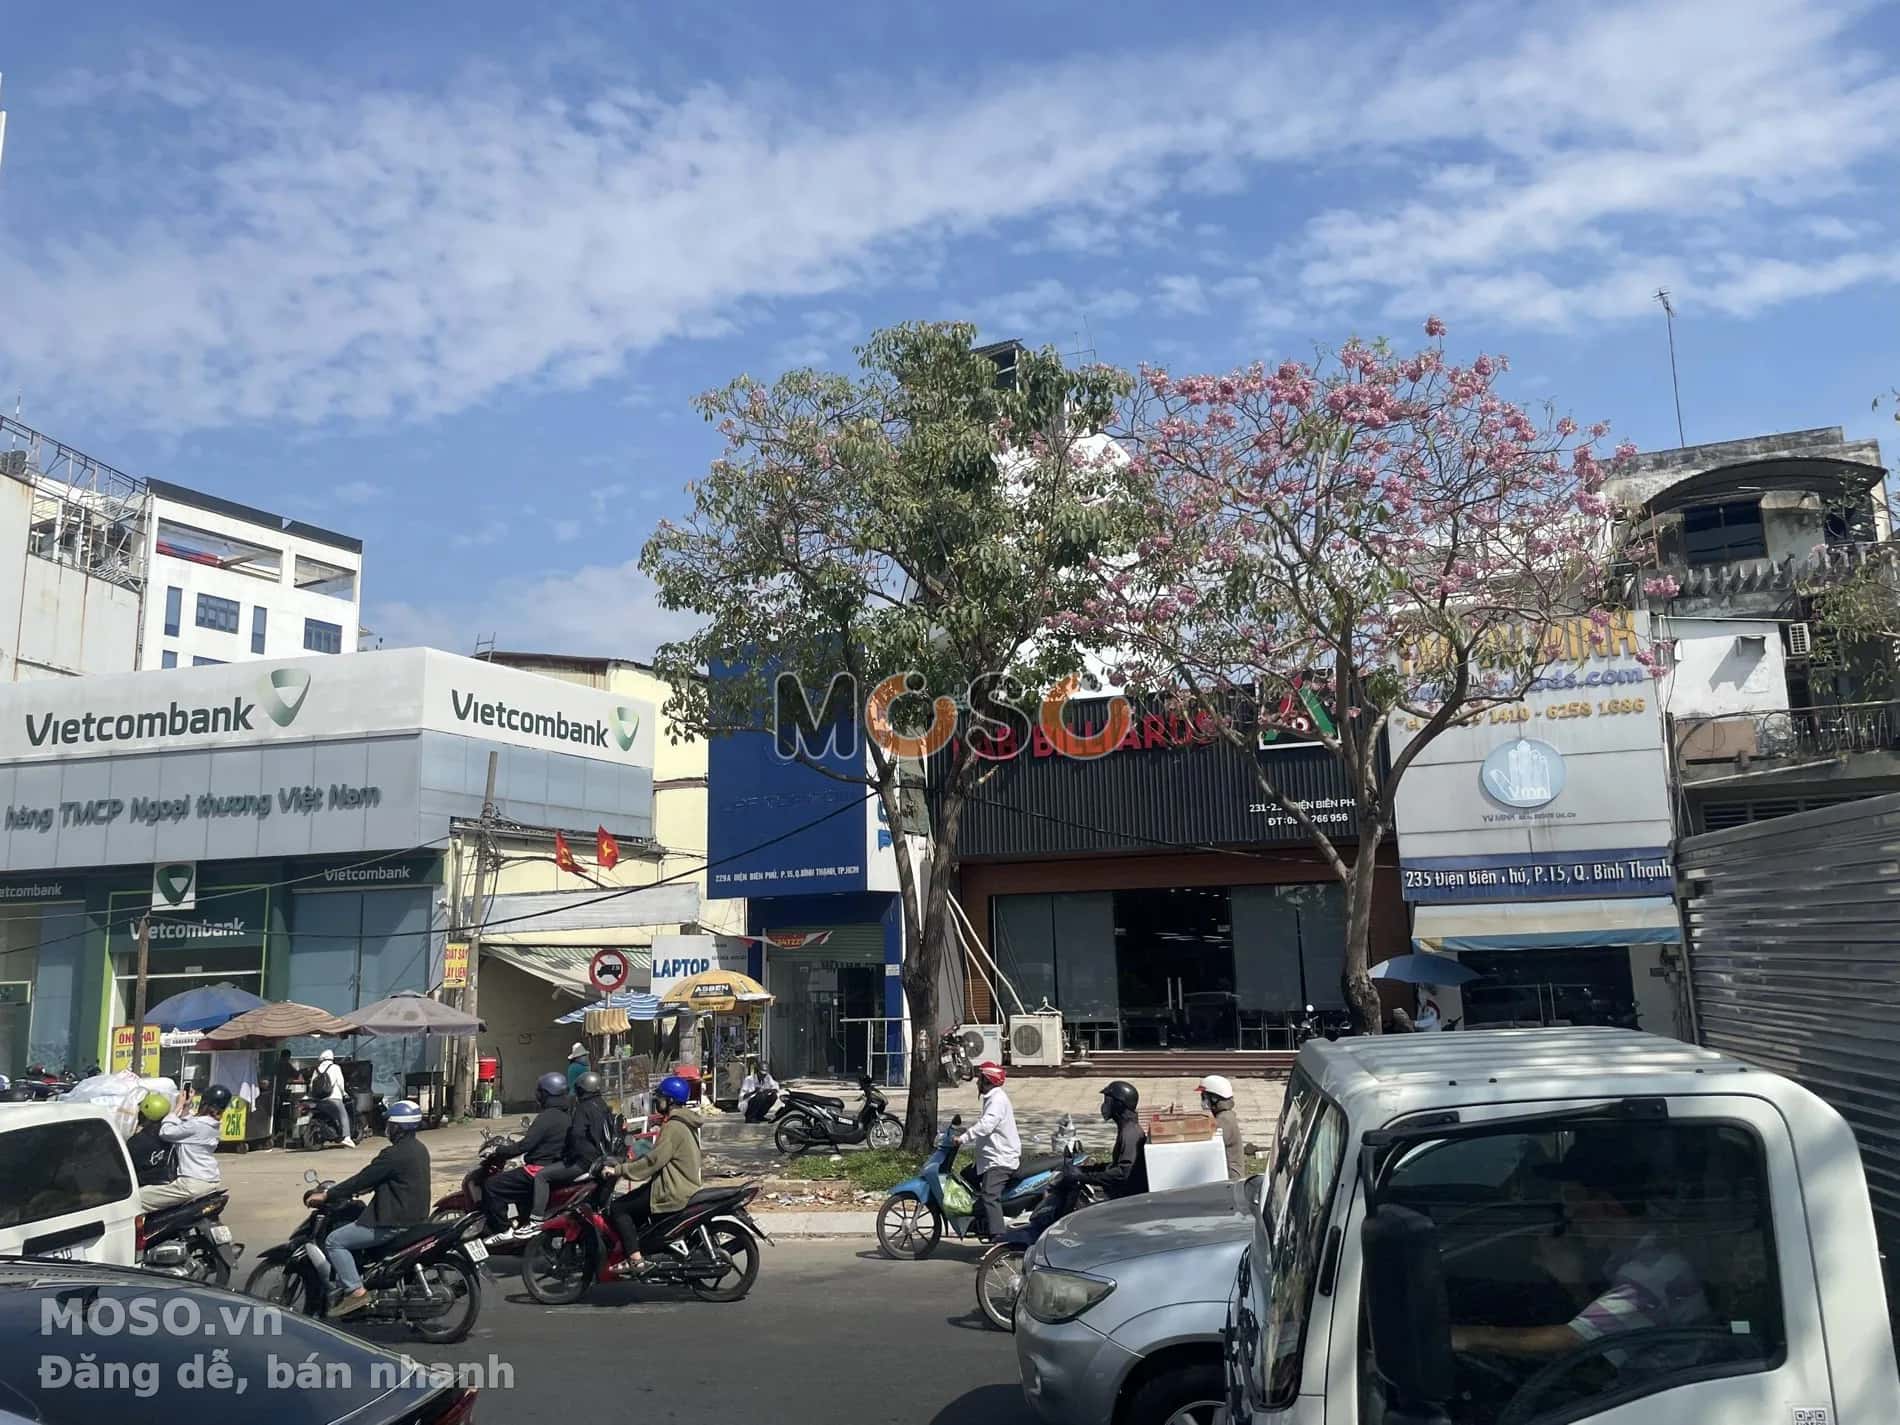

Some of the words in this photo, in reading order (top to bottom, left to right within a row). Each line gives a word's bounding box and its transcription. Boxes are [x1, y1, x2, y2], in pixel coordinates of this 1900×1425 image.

[26, 697, 255, 747] Vietcombank
[451, 689, 609, 748] Vietcombank
[59, 798, 124, 828] TMCP
[130, 794, 191, 826] Ngoại
[278, 785, 323, 817] Việt
[328, 783, 381, 811] Nam
[1316, 797, 1338, 809] BIÊN
[1340, 798, 1358, 808] PH
[324, 864, 411, 881] Vietcombank
[1406, 870, 1431, 888] 235
[1574, 865, 1590, 881] Q.
[1593, 862, 1624, 880] Bình
[1628, 859, 1672, 881] Thạnh
[129, 917, 246, 940] Vetcombank
[652, 958, 710, 978] LAPTOP
[225, 1113, 242, 1136] 25K
